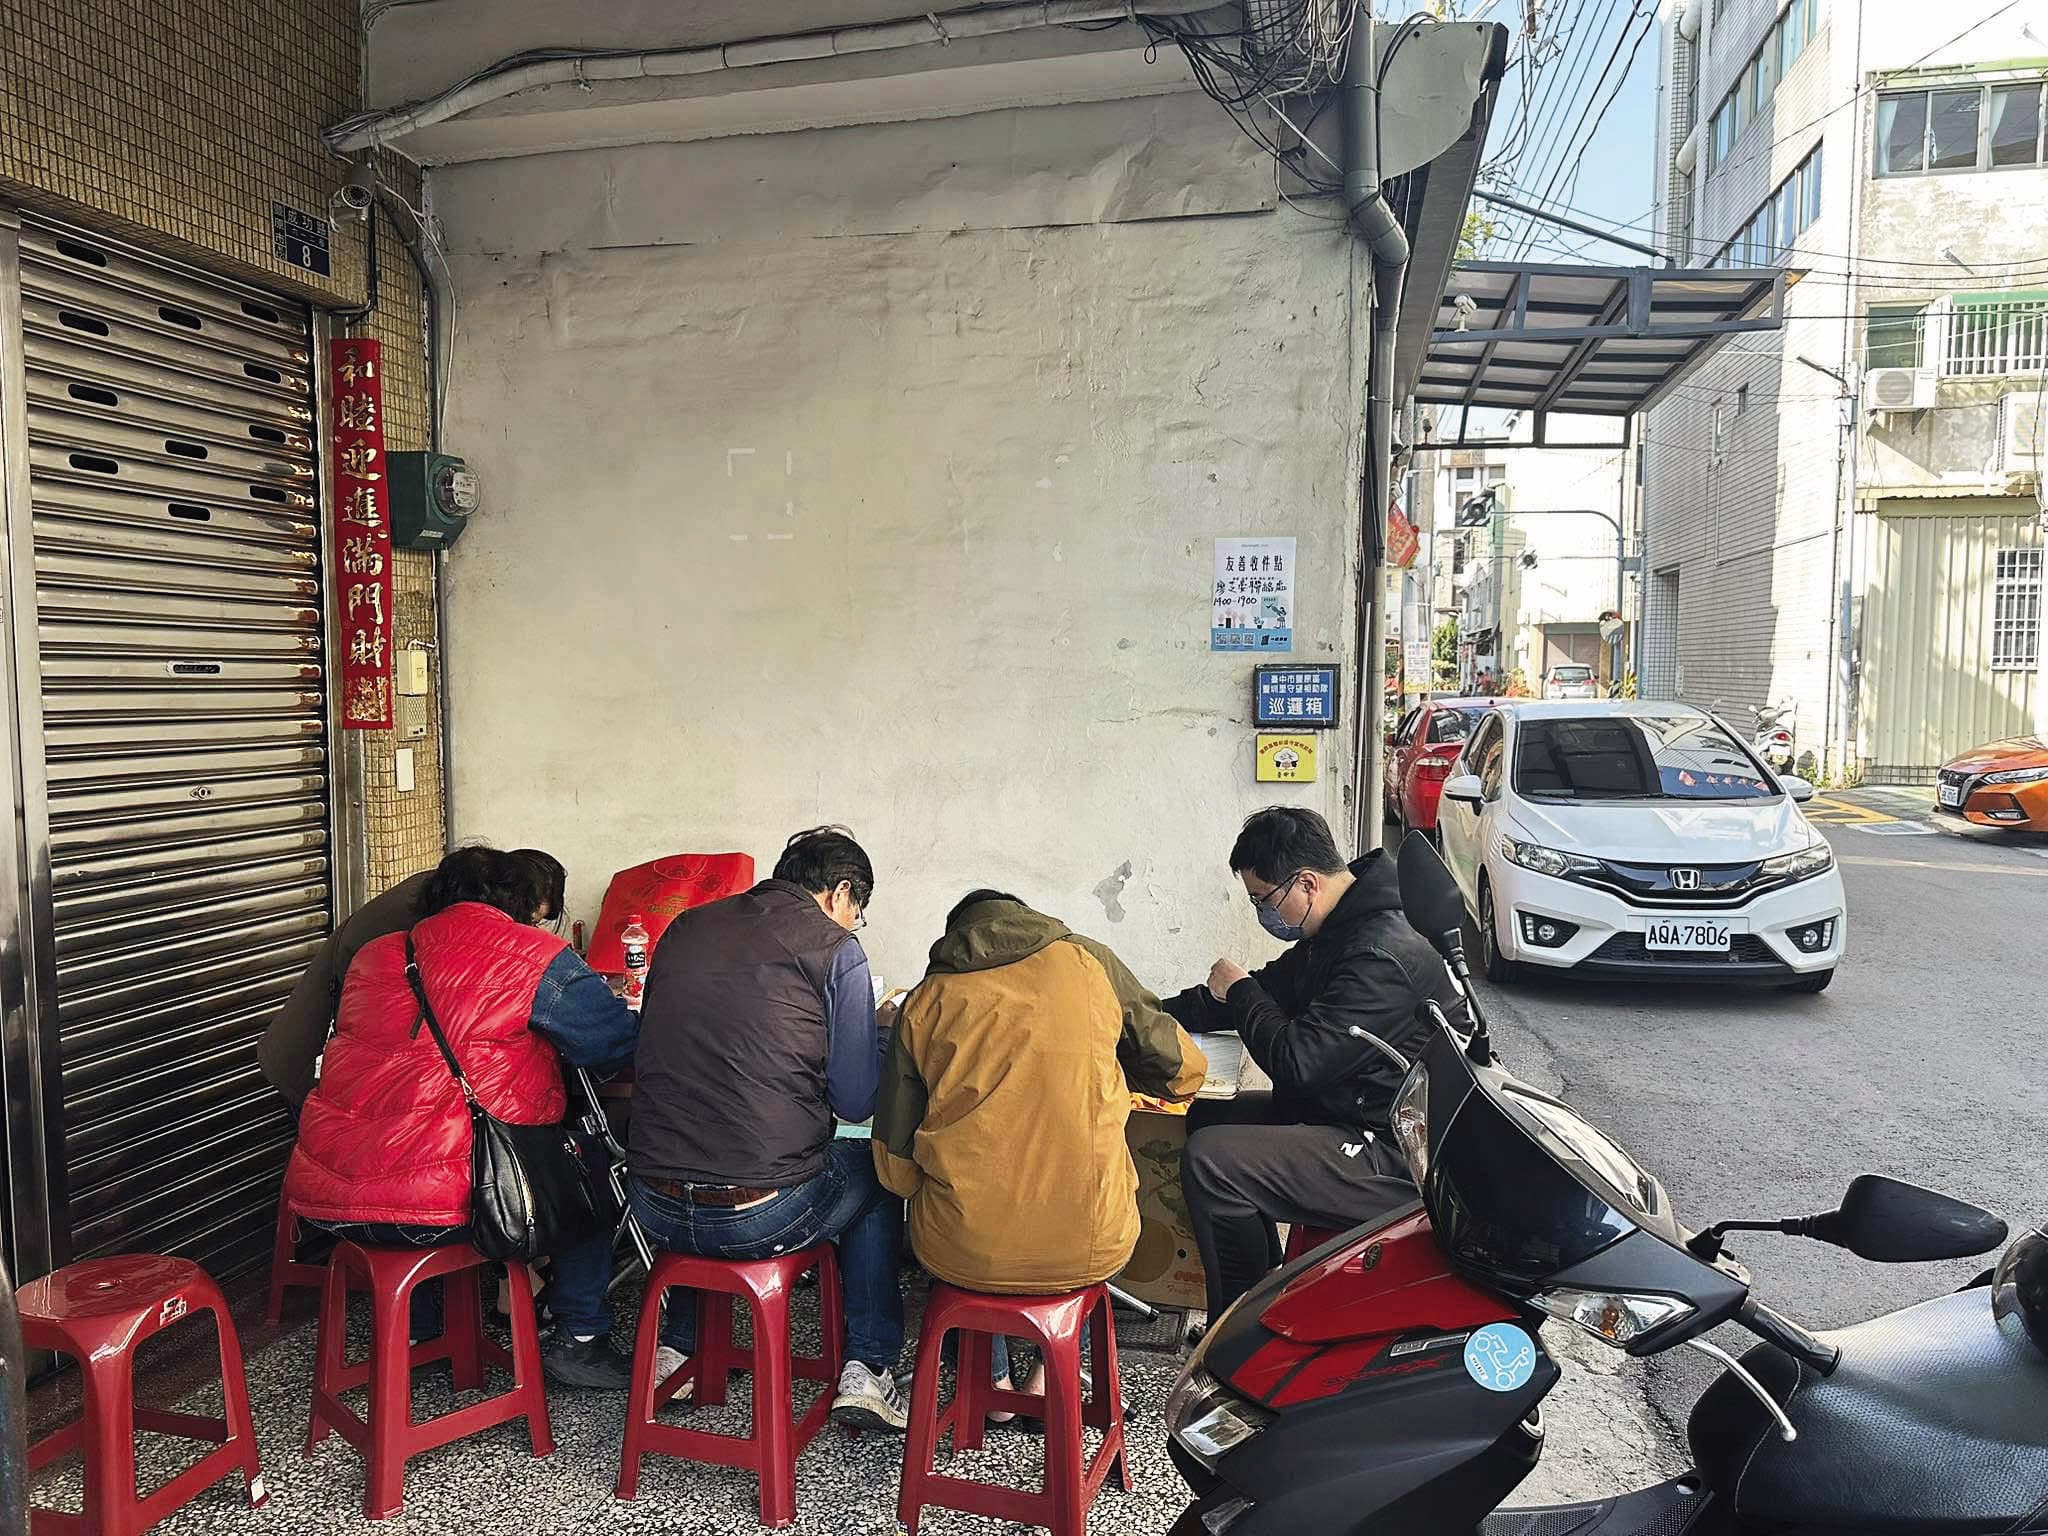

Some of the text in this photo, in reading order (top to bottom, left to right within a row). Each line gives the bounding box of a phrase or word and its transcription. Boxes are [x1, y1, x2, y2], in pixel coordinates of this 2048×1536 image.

[302, 245, 312, 267] 8
[1226, 555, 1283, 572] 友善收件點
[1268, 697, 1323, 715] 巡邏箱
[1647, 925, 1728, 946] AQA-7806
